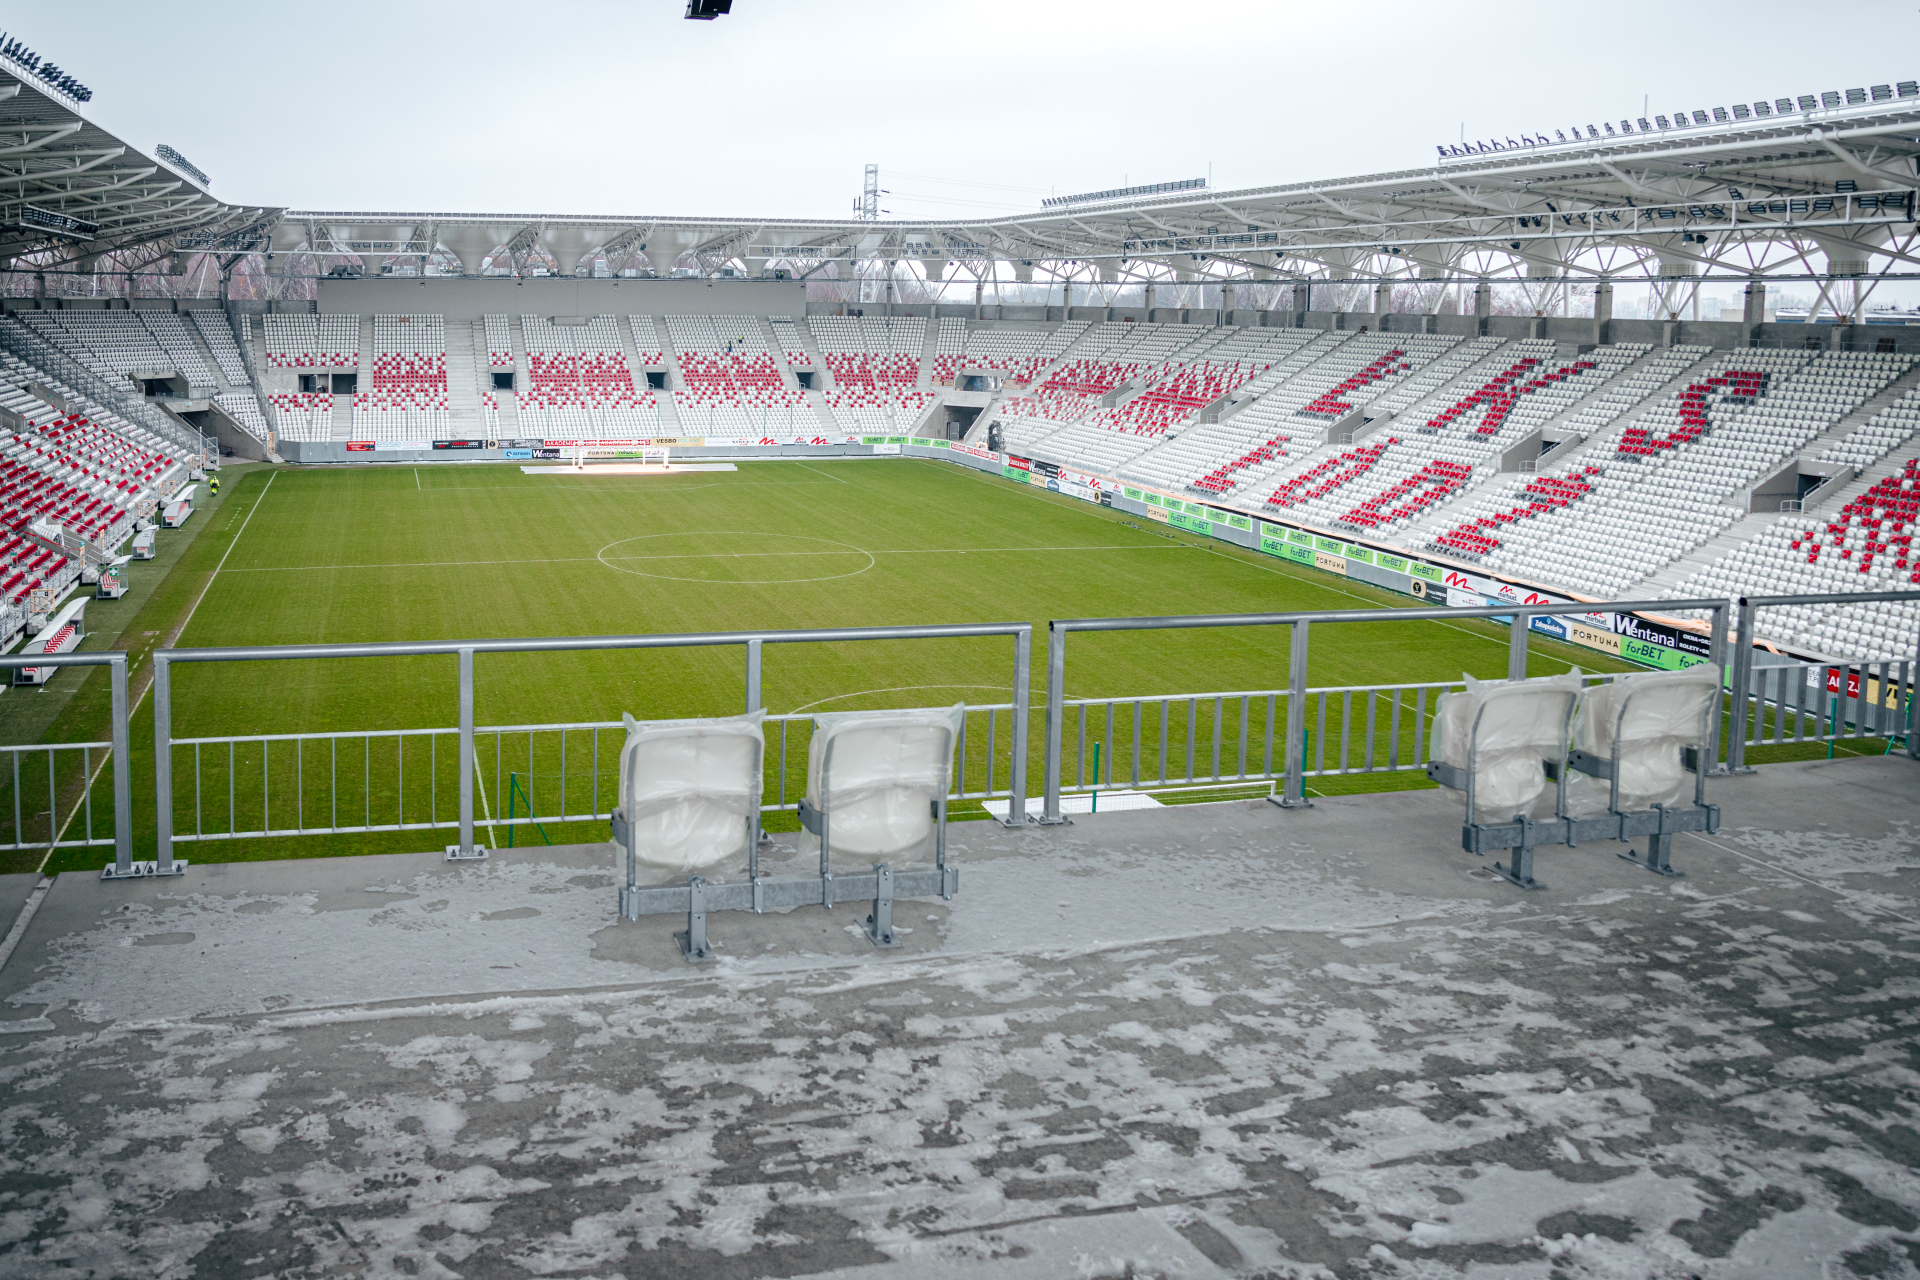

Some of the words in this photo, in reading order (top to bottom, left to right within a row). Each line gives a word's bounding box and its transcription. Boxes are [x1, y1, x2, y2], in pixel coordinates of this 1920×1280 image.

[532, 449, 560, 458] Wentana
[1170, 512, 1187, 523] forBET
[1209, 509, 1224, 520] forBET
[1191, 518, 1209, 531] forBET
[1231, 516, 1247, 526] forBET
[1266, 525, 1283, 536] forBET
[1290, 531, 1308, 542] forBET
[1263, 539, 1284, 552] forBET
[1320, 540, 1339, 551] forBET
[1290, 546, 1312, 560] forBET
[1348, 546, 1368, 558] forBET
[1315, 556, 1345, 570] FORTUNA
[1382, 556, 1403, 568] forBET
[1413, 564, 1436, 577] forBET
[1497, 591, 1517, 601] mirbud
[1584, 614, 1607, 625] mirbud
[1616, 614, 1675, 647] Wentana
[1573, 629, 1619, 649] FORTUNA
[1626, 641, 1666, 660] forBET
